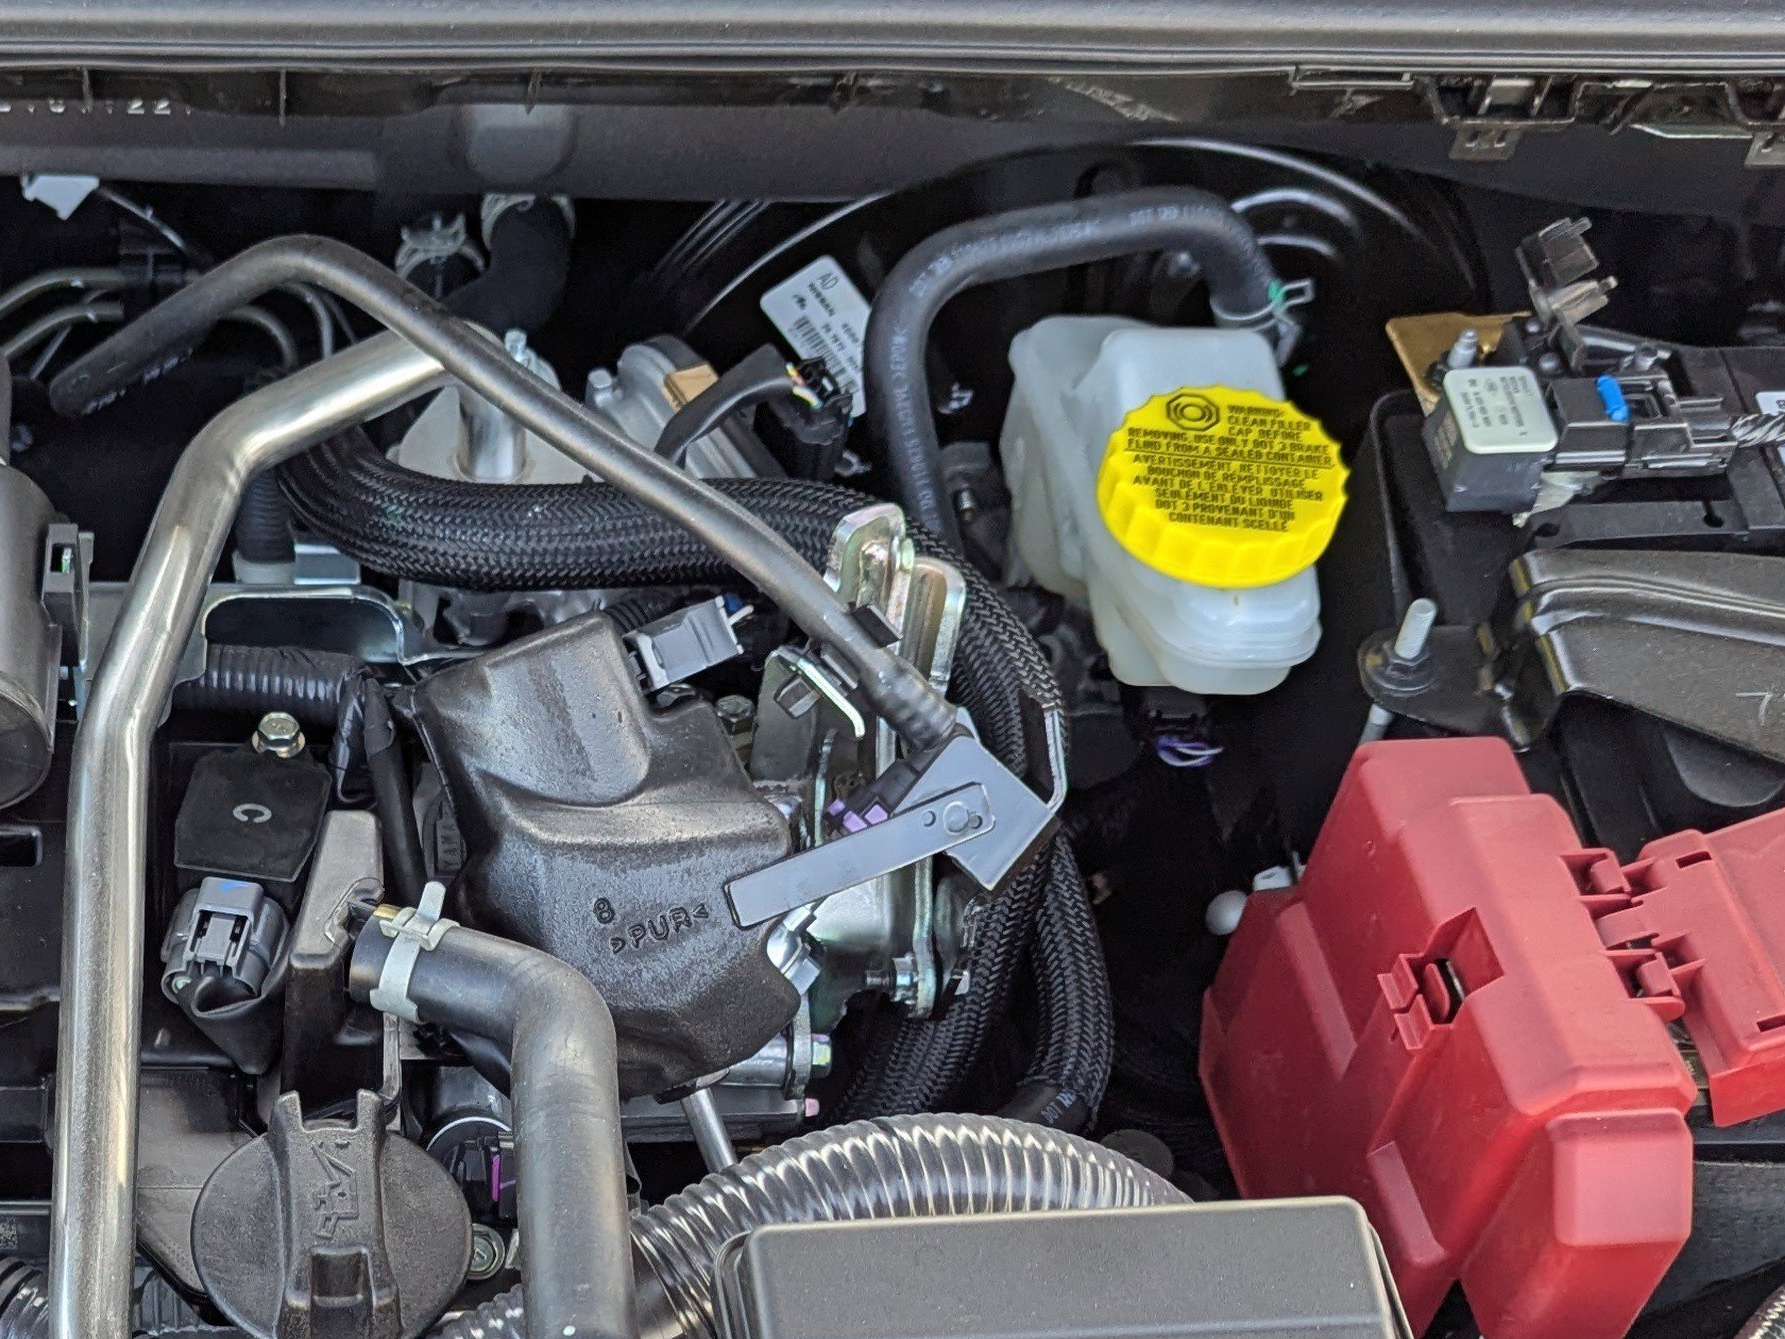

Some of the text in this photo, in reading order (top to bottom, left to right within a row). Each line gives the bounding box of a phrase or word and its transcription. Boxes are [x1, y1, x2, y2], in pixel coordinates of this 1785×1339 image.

[1228, 426, 1253, 437] CAP
[232, 803, 273, 824] C
[593, 897, 616, 925] 8
